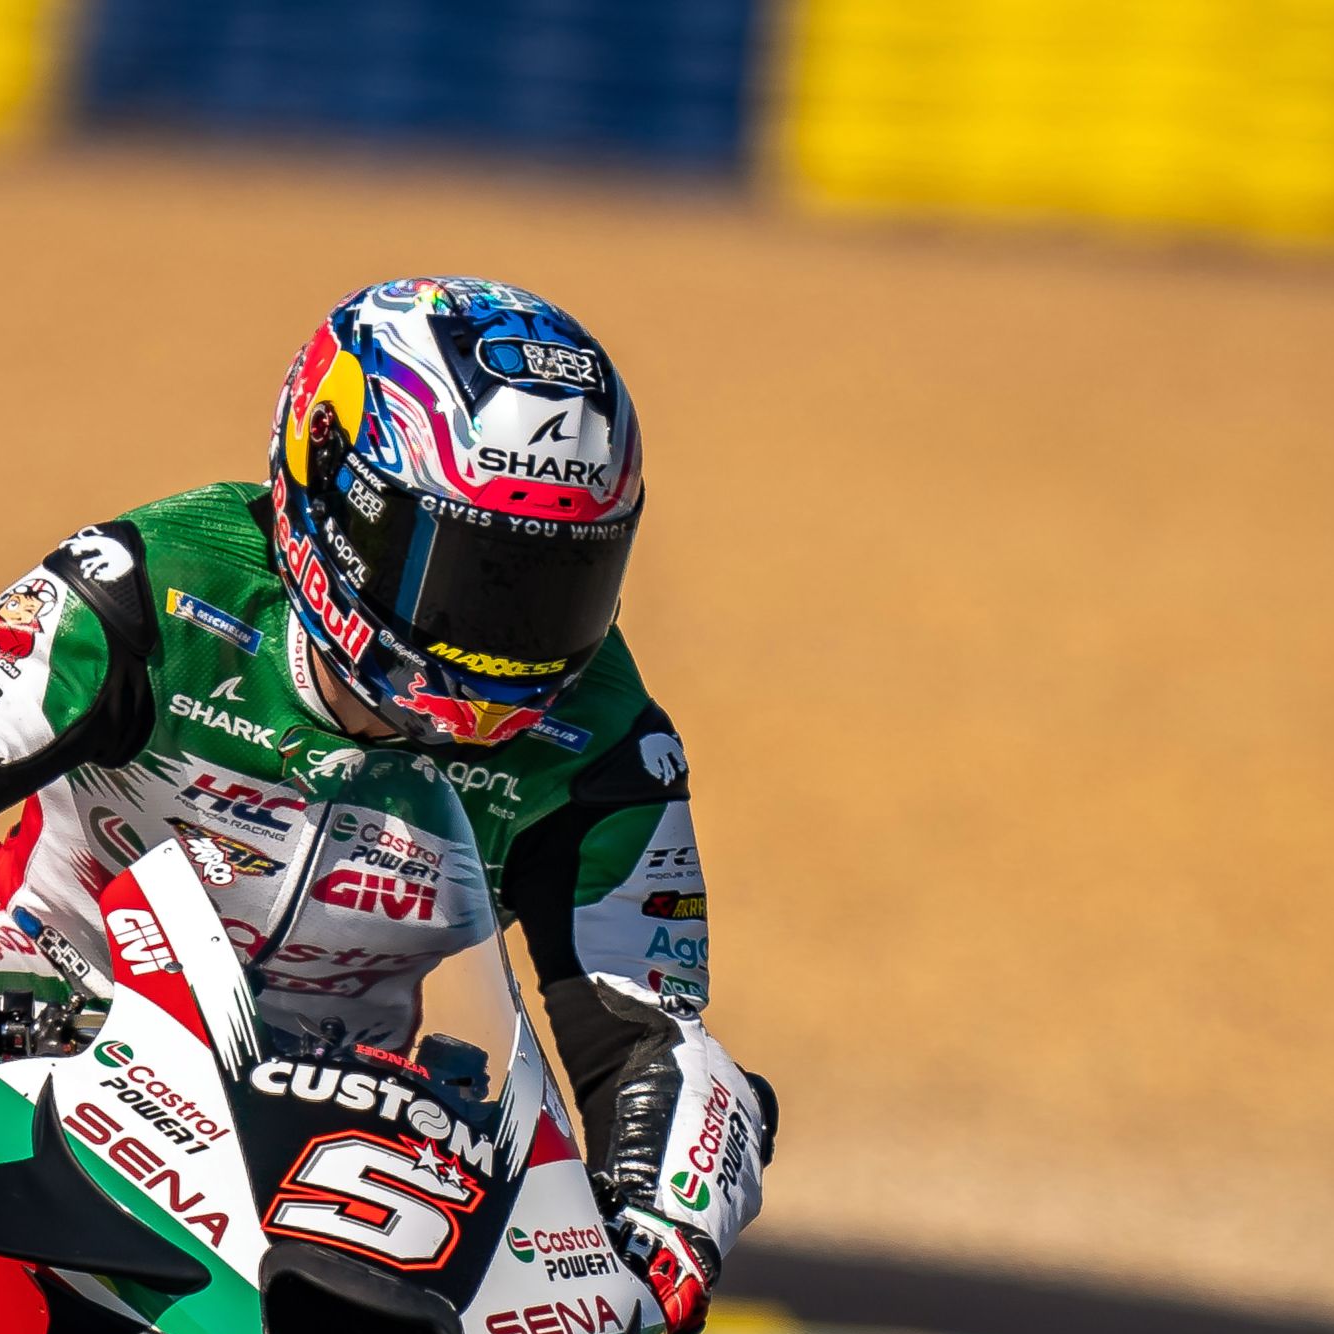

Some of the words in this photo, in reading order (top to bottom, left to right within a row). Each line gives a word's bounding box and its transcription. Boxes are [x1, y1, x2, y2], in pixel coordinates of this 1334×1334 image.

[527, 359, 596, 383] LOCK
[347, 452, 387, 493] SHARK
[477, 446, 609, 487] SHARK
[347, 489, 381, 523] LOCK
[352, 480, 387, 512] QUAD
[421, 495, 493, 527] GIVES
[508, 516, 558, 537] YOU
[570, 523, 627, 540] WINGS
[272, 468, 313, 585] Red
[302, 554, 375, 664] Bull
[335, 534, 368, 583] april
[196, 609, 251, 643] MICHELIN
[427, 642, 568, 676] MAXXESS
[169, 693, 277, 750] SHARK
[180, 773, 308, 832] HRC
[447, 761, 521, 801] april
[229, 819, 287, 842] RACING
[360, 823, 444, 867] Castrol
[311, 868, 438, 921] GIVI
[44, 927, 90, 978] QUAD
[106, 908, 175, 976] GIVI
[354, 1043, 431, 1080] HONDA
[99, 1077, 210, 1155] POWER1
[127, 1066, 231, 1141] Castrol
[251, 1061, 494, 1177] CUSTOM
[689, 1074, 733, 1174] Castrol
[716, 1097, 754, 1205] POWER1
[62, 1102, 229, 1249] SENA
[264, 1131, 483, 1269] 5
[534, 1224, 607, 1255] Castrol
[544, 1251, 620, 1282] POWER1
